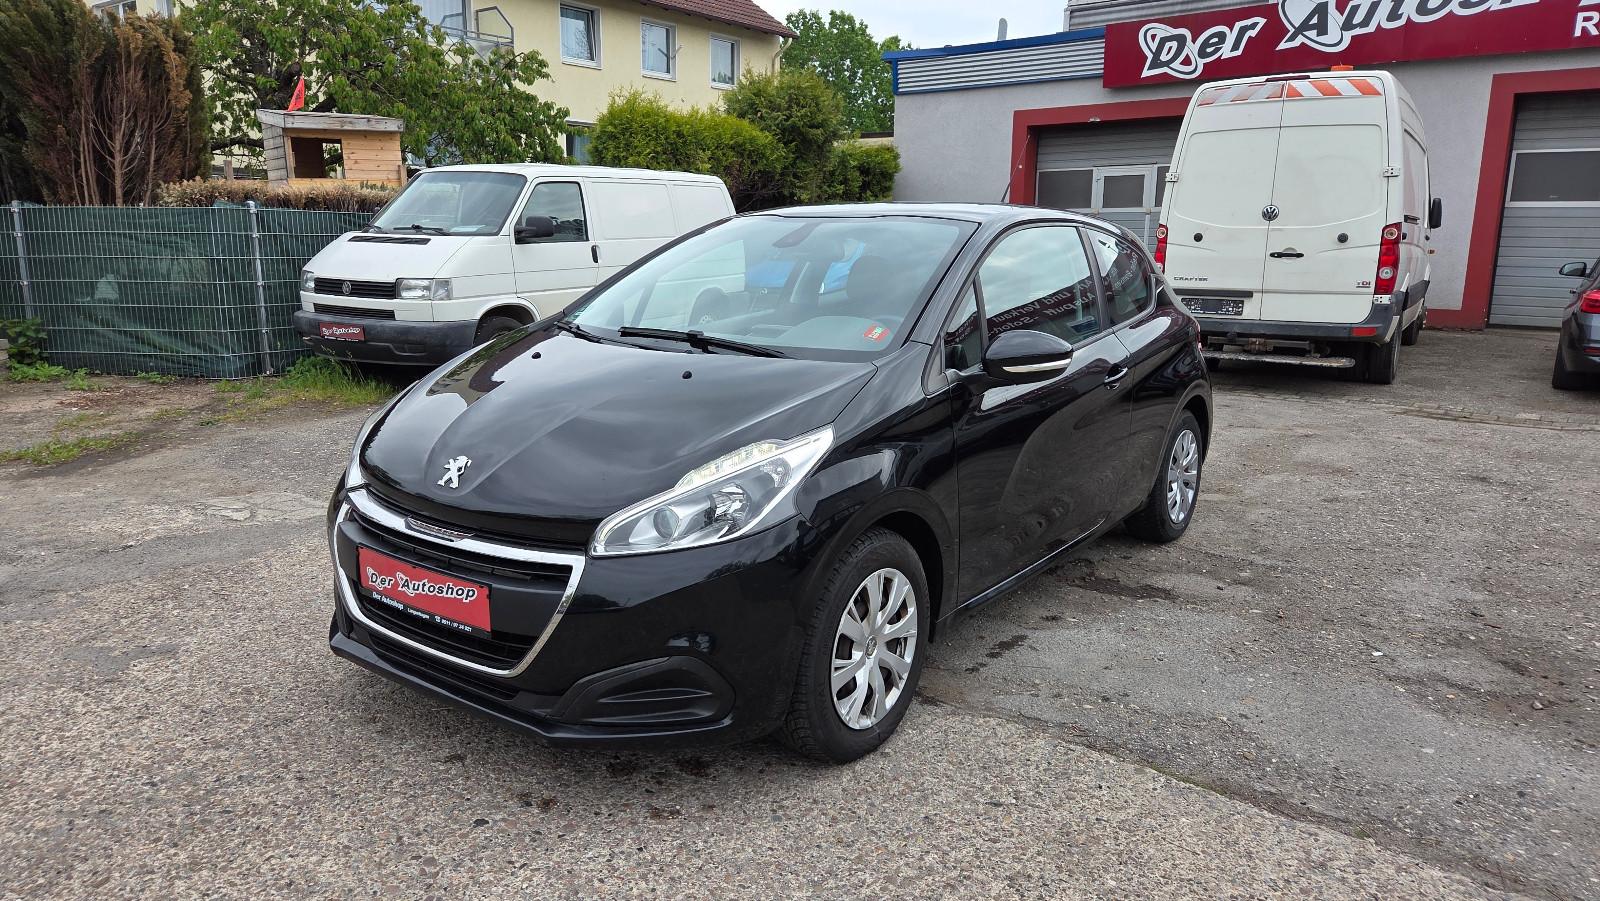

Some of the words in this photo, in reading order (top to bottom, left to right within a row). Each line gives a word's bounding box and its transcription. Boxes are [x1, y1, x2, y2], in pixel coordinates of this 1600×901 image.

[1142, 18, 1264, 77] Der
[1279, 0, 1520, 49] Auto
[367, 567, 394, 589] Der
[397, 572, 477, 602] Autoshop
[372, 591, 381, 600] Der
[381, 595, 404, 610] Autoshop
